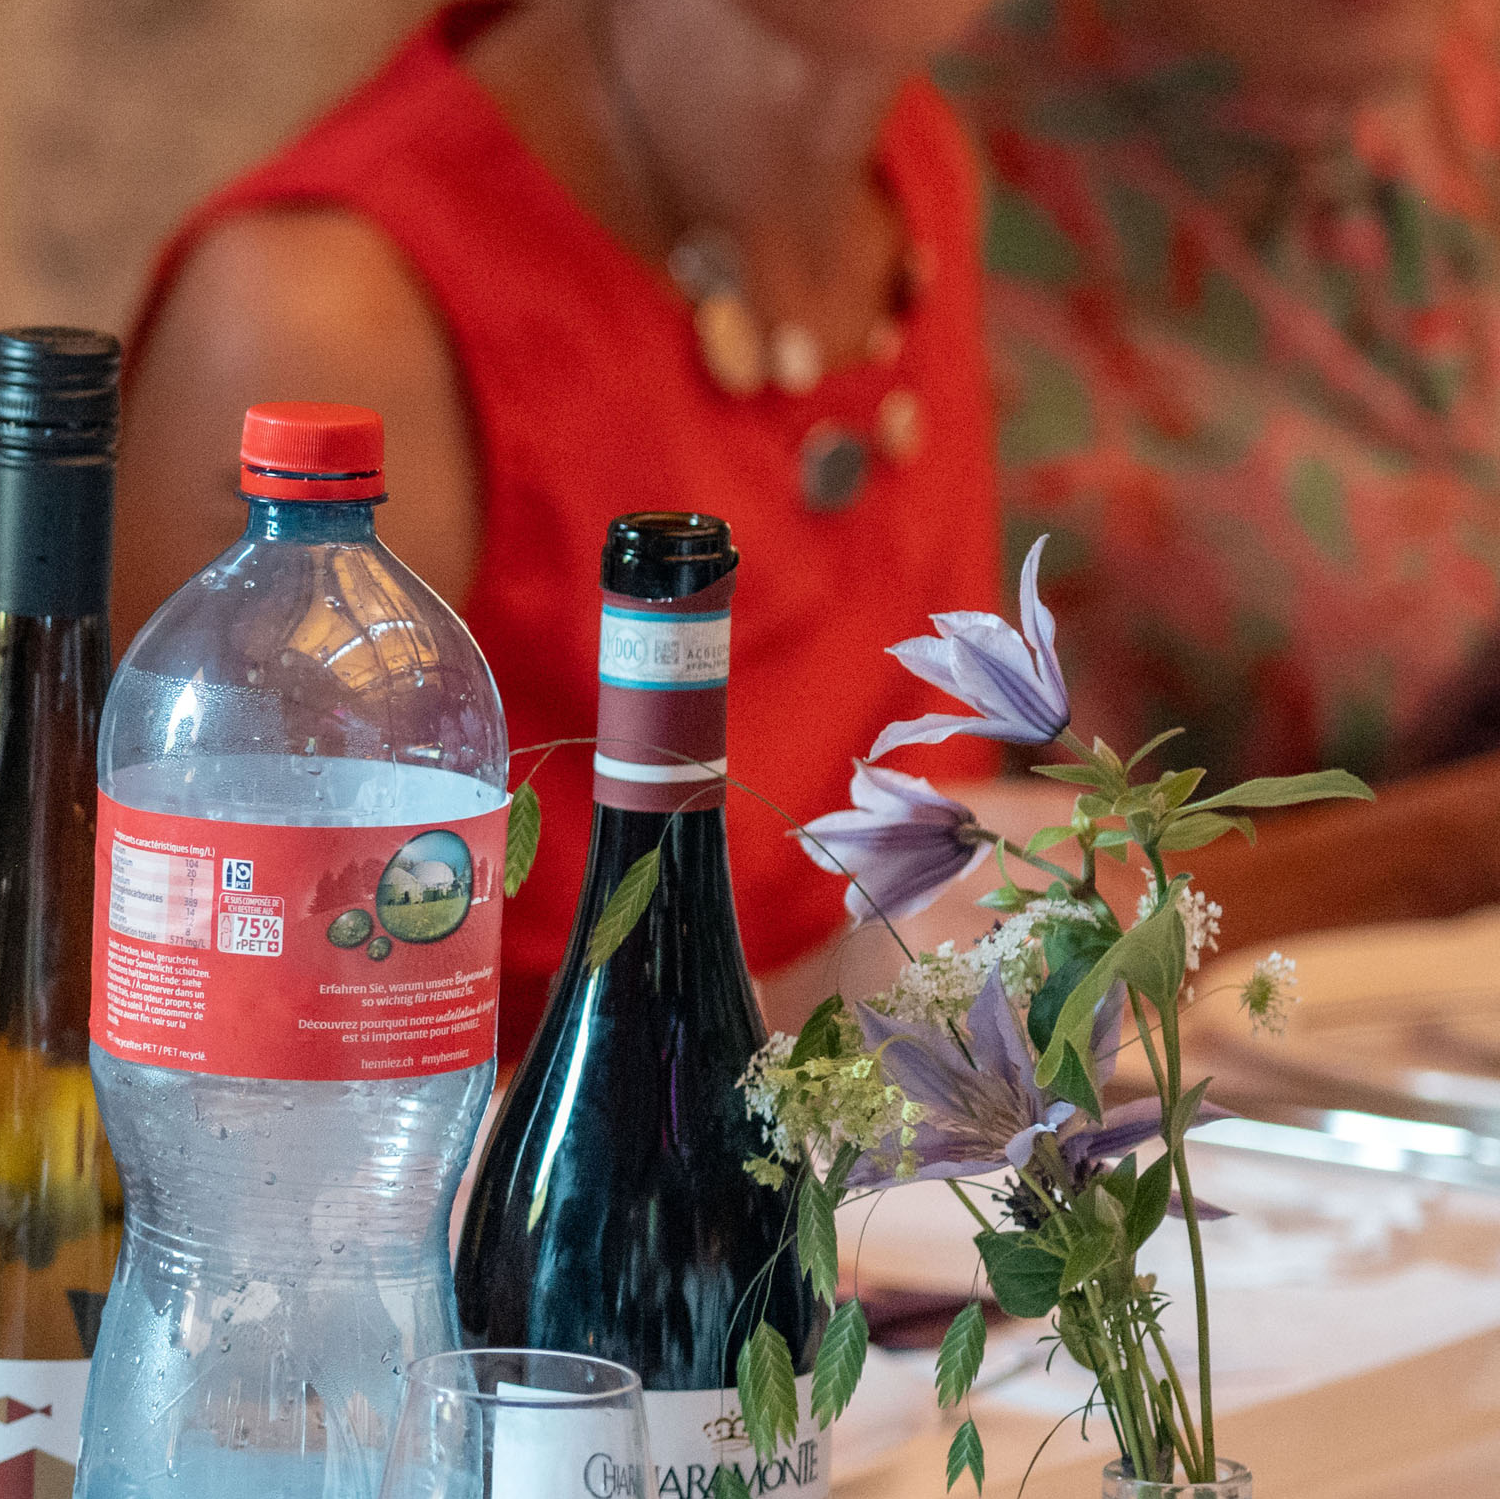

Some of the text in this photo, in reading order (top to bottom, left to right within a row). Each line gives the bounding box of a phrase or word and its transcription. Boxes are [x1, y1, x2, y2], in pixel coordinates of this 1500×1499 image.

[615, 637, 643, 660] DOC
[136, 838, 188, 854] caractéristiques
[190, 845, 215, 858] (mg/L)
[185, 859, 199, 868] 104
[187, 869, 196, 877] 20
[184, 897, 198, 907] 389
[272, 899, 279, 907] DE
[237, 916, 279, 939] 75%
[138, 930, 156, 940] totale
[170, 935, 184, 945] 571
[186, 937, 206, 949] mg/L
[236, 939, 267, 952] rPET
[136, 959, 173, 973] Sonnenlicht
[175, 966, 210, 978] schützen.
[157, 954, 198, 966] geruchsfrei
[150, 973, 159, 982] bis
[182, 978, 202, 988] siehe
[319, 983, 367, 995] Erfahren
[369, 982, 387, 995] Sie,
[389, 982, 424, 993] warum
[426, 978, 453, 990] unsere
[141, 982, 173, 995] conserver
[175, 987, 193, 998] dans
[195, 990, 204, 999] un
[362, 998, 374, 1007] so
[377, 994, 414, 1007] wichtig
[415, 993, 429, 1004] für
[430, 987, 465, 1002] HENNIEZ
[130, 991, 142, 1000] sans
[165, 997, 191, 1010] propre,
[193, 1001, 206, 1010] sec
[151, 1006, 192, 1019] consommer
[194, 1010, 203, 1020] de
[299, 1018, 357, 1030] Découvrez
[360, 1017, 408, 1031] pourquoi
[410, 1015, 434, 1026] notre
[436, 1004, 475, 1022] installation
[152, 1016, 165, 1026] voir
[166, 1020, 178, 1028] sur
[179, 1019, 186, 1029] la
[342, 1034, 359, 1043] est
[361, 1032, 370, 1042] si
[372, 1029, 428, 1043] importante
[430, 1026, 450, 1039] pour
[143, 1042, 157, 1053] PET
[163, 1046, 178, 1057] PET
[179, 1049, 207, 1061] recyclé.
[361, 1049, 470, 1069] henniez.ch #myhenniez
